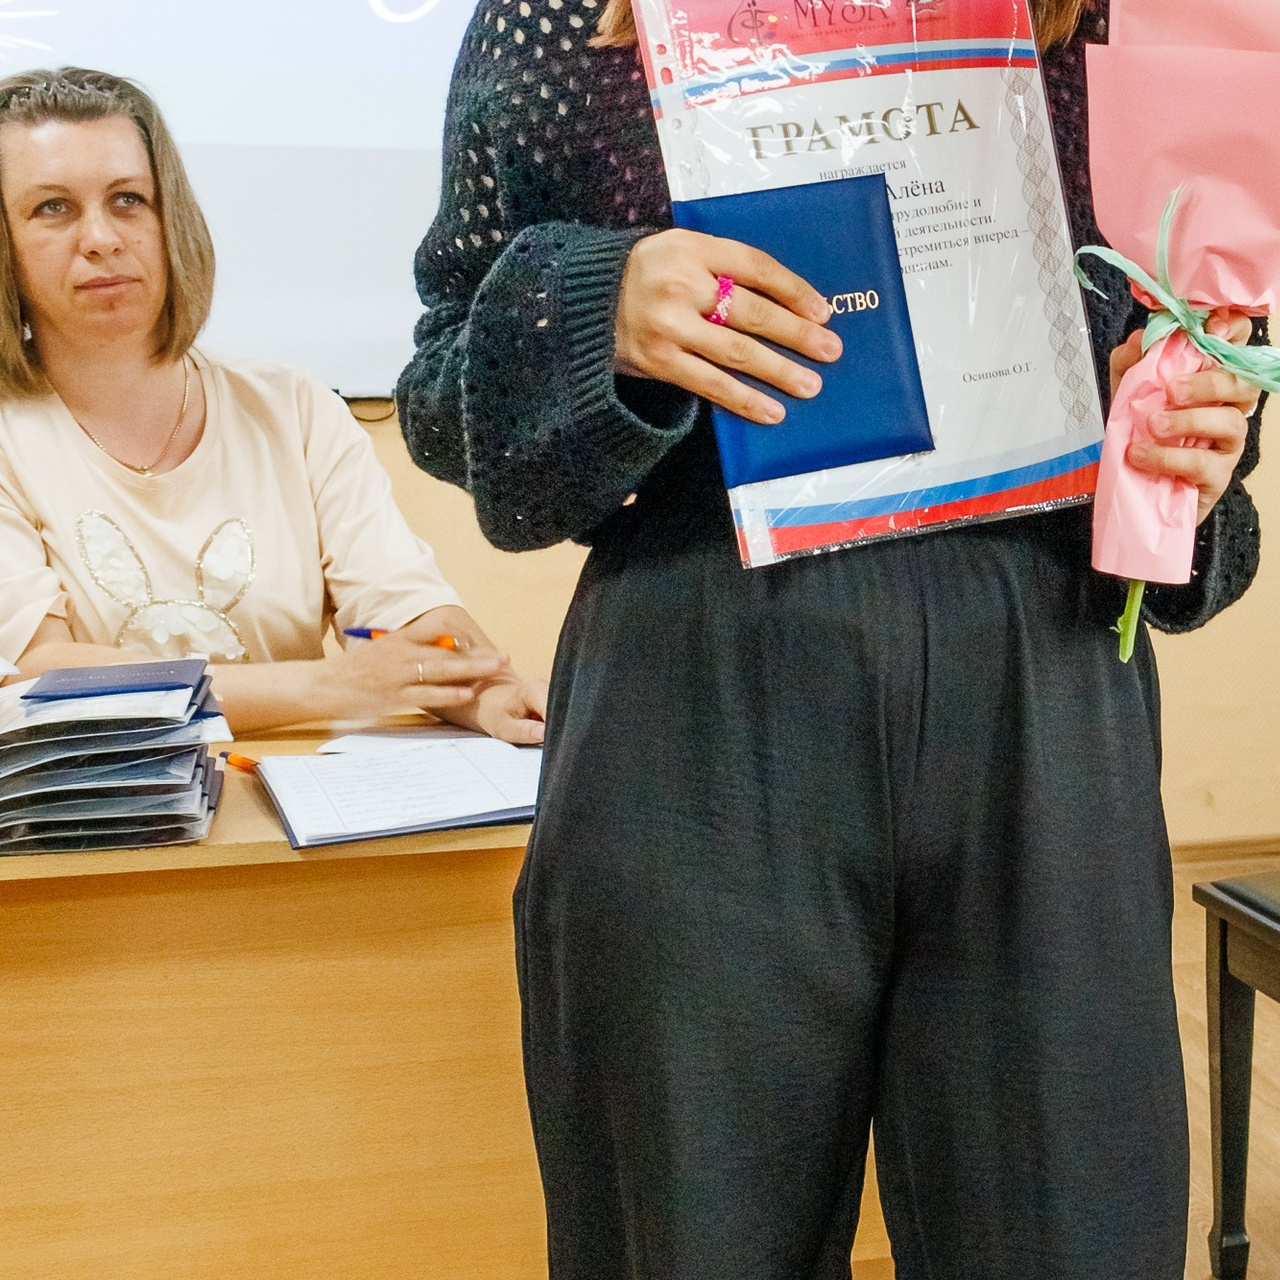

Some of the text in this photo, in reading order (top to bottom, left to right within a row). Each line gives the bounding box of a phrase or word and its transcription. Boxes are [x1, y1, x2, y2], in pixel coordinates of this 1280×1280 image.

[746, 98, 980, 160] ГРАМОТА
[973, 198, 982, 208] и
[962, 369, 1011, 383] Осипова
